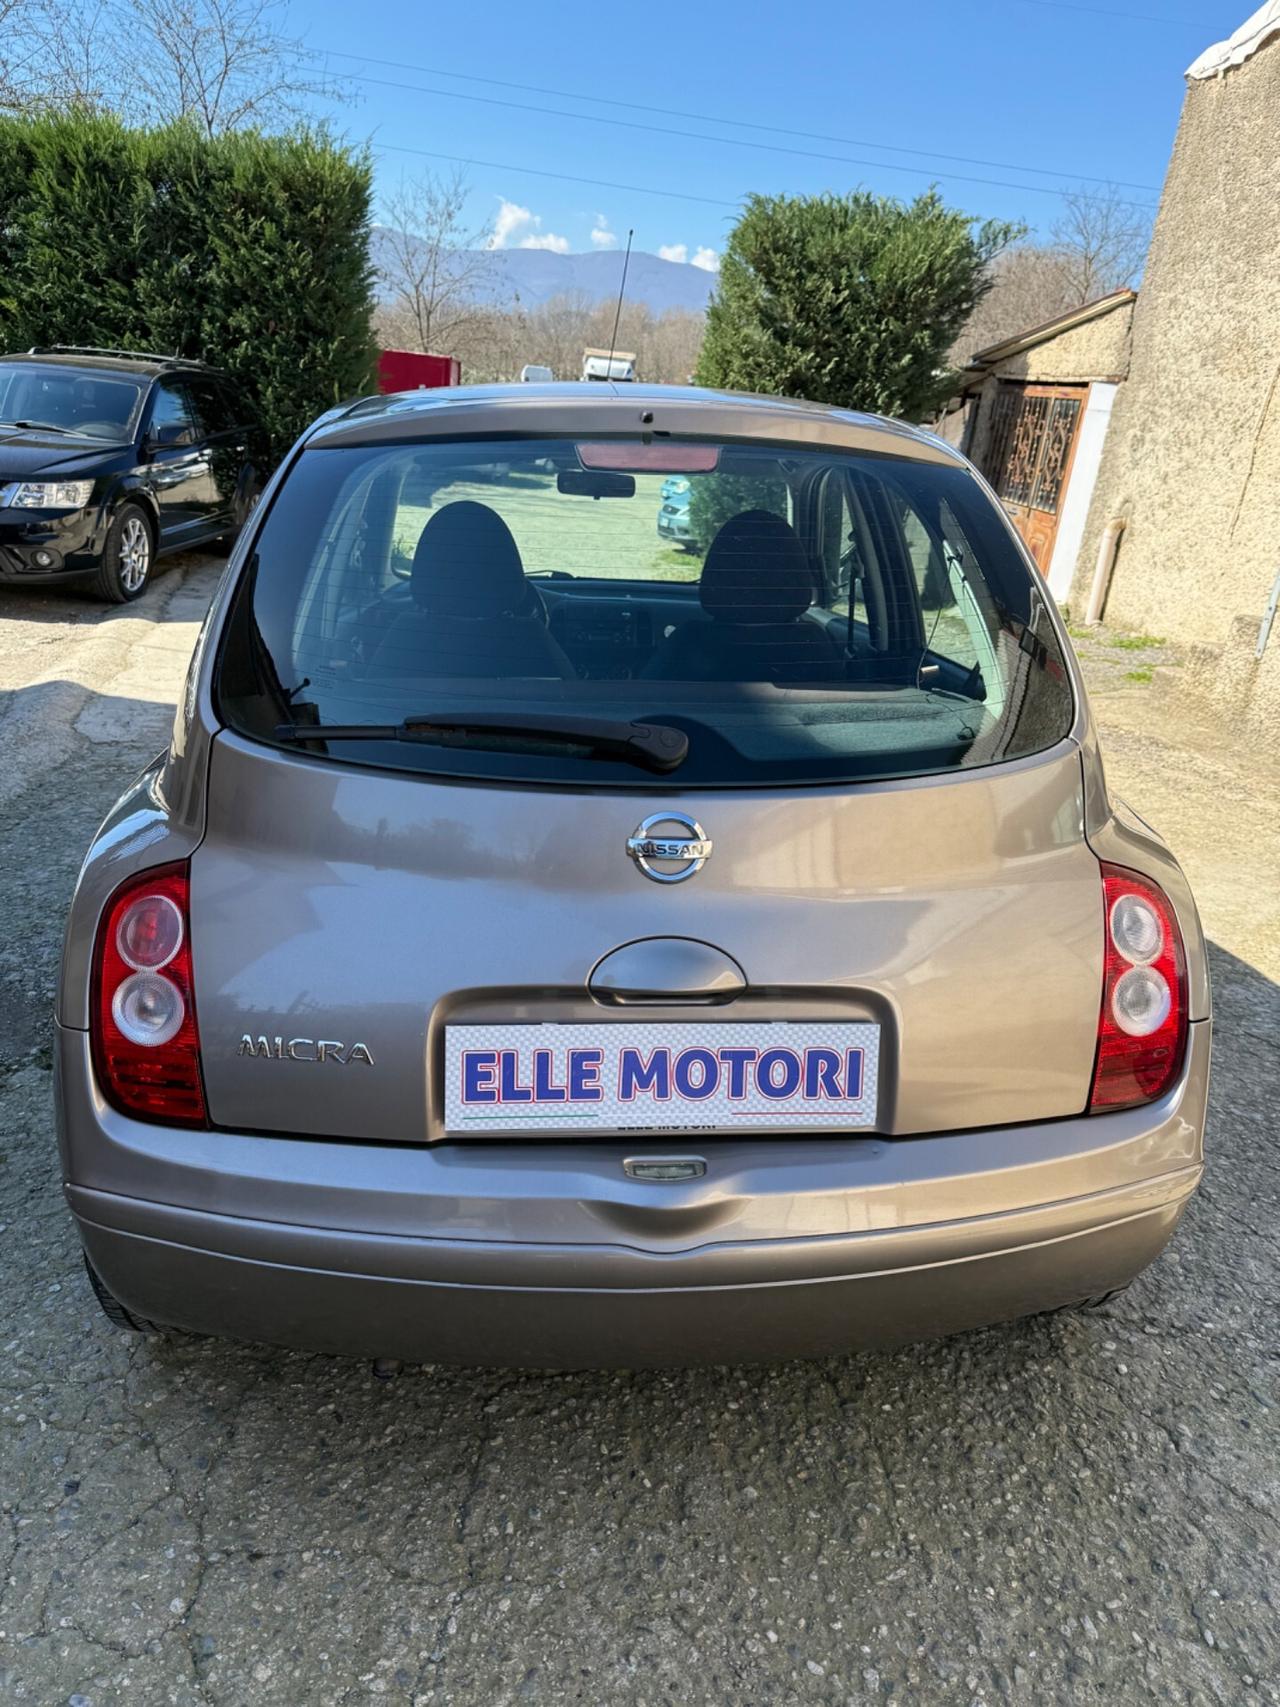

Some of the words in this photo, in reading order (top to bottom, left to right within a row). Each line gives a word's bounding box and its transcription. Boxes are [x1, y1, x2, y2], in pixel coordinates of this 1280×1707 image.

[636, 842, 704, 856] NISSAN
[238, 1034, 375, 1065] MICRA
[463, 1048, 603, 1104] ELLE
[617, 1047, 865, 1101] MOTORI
